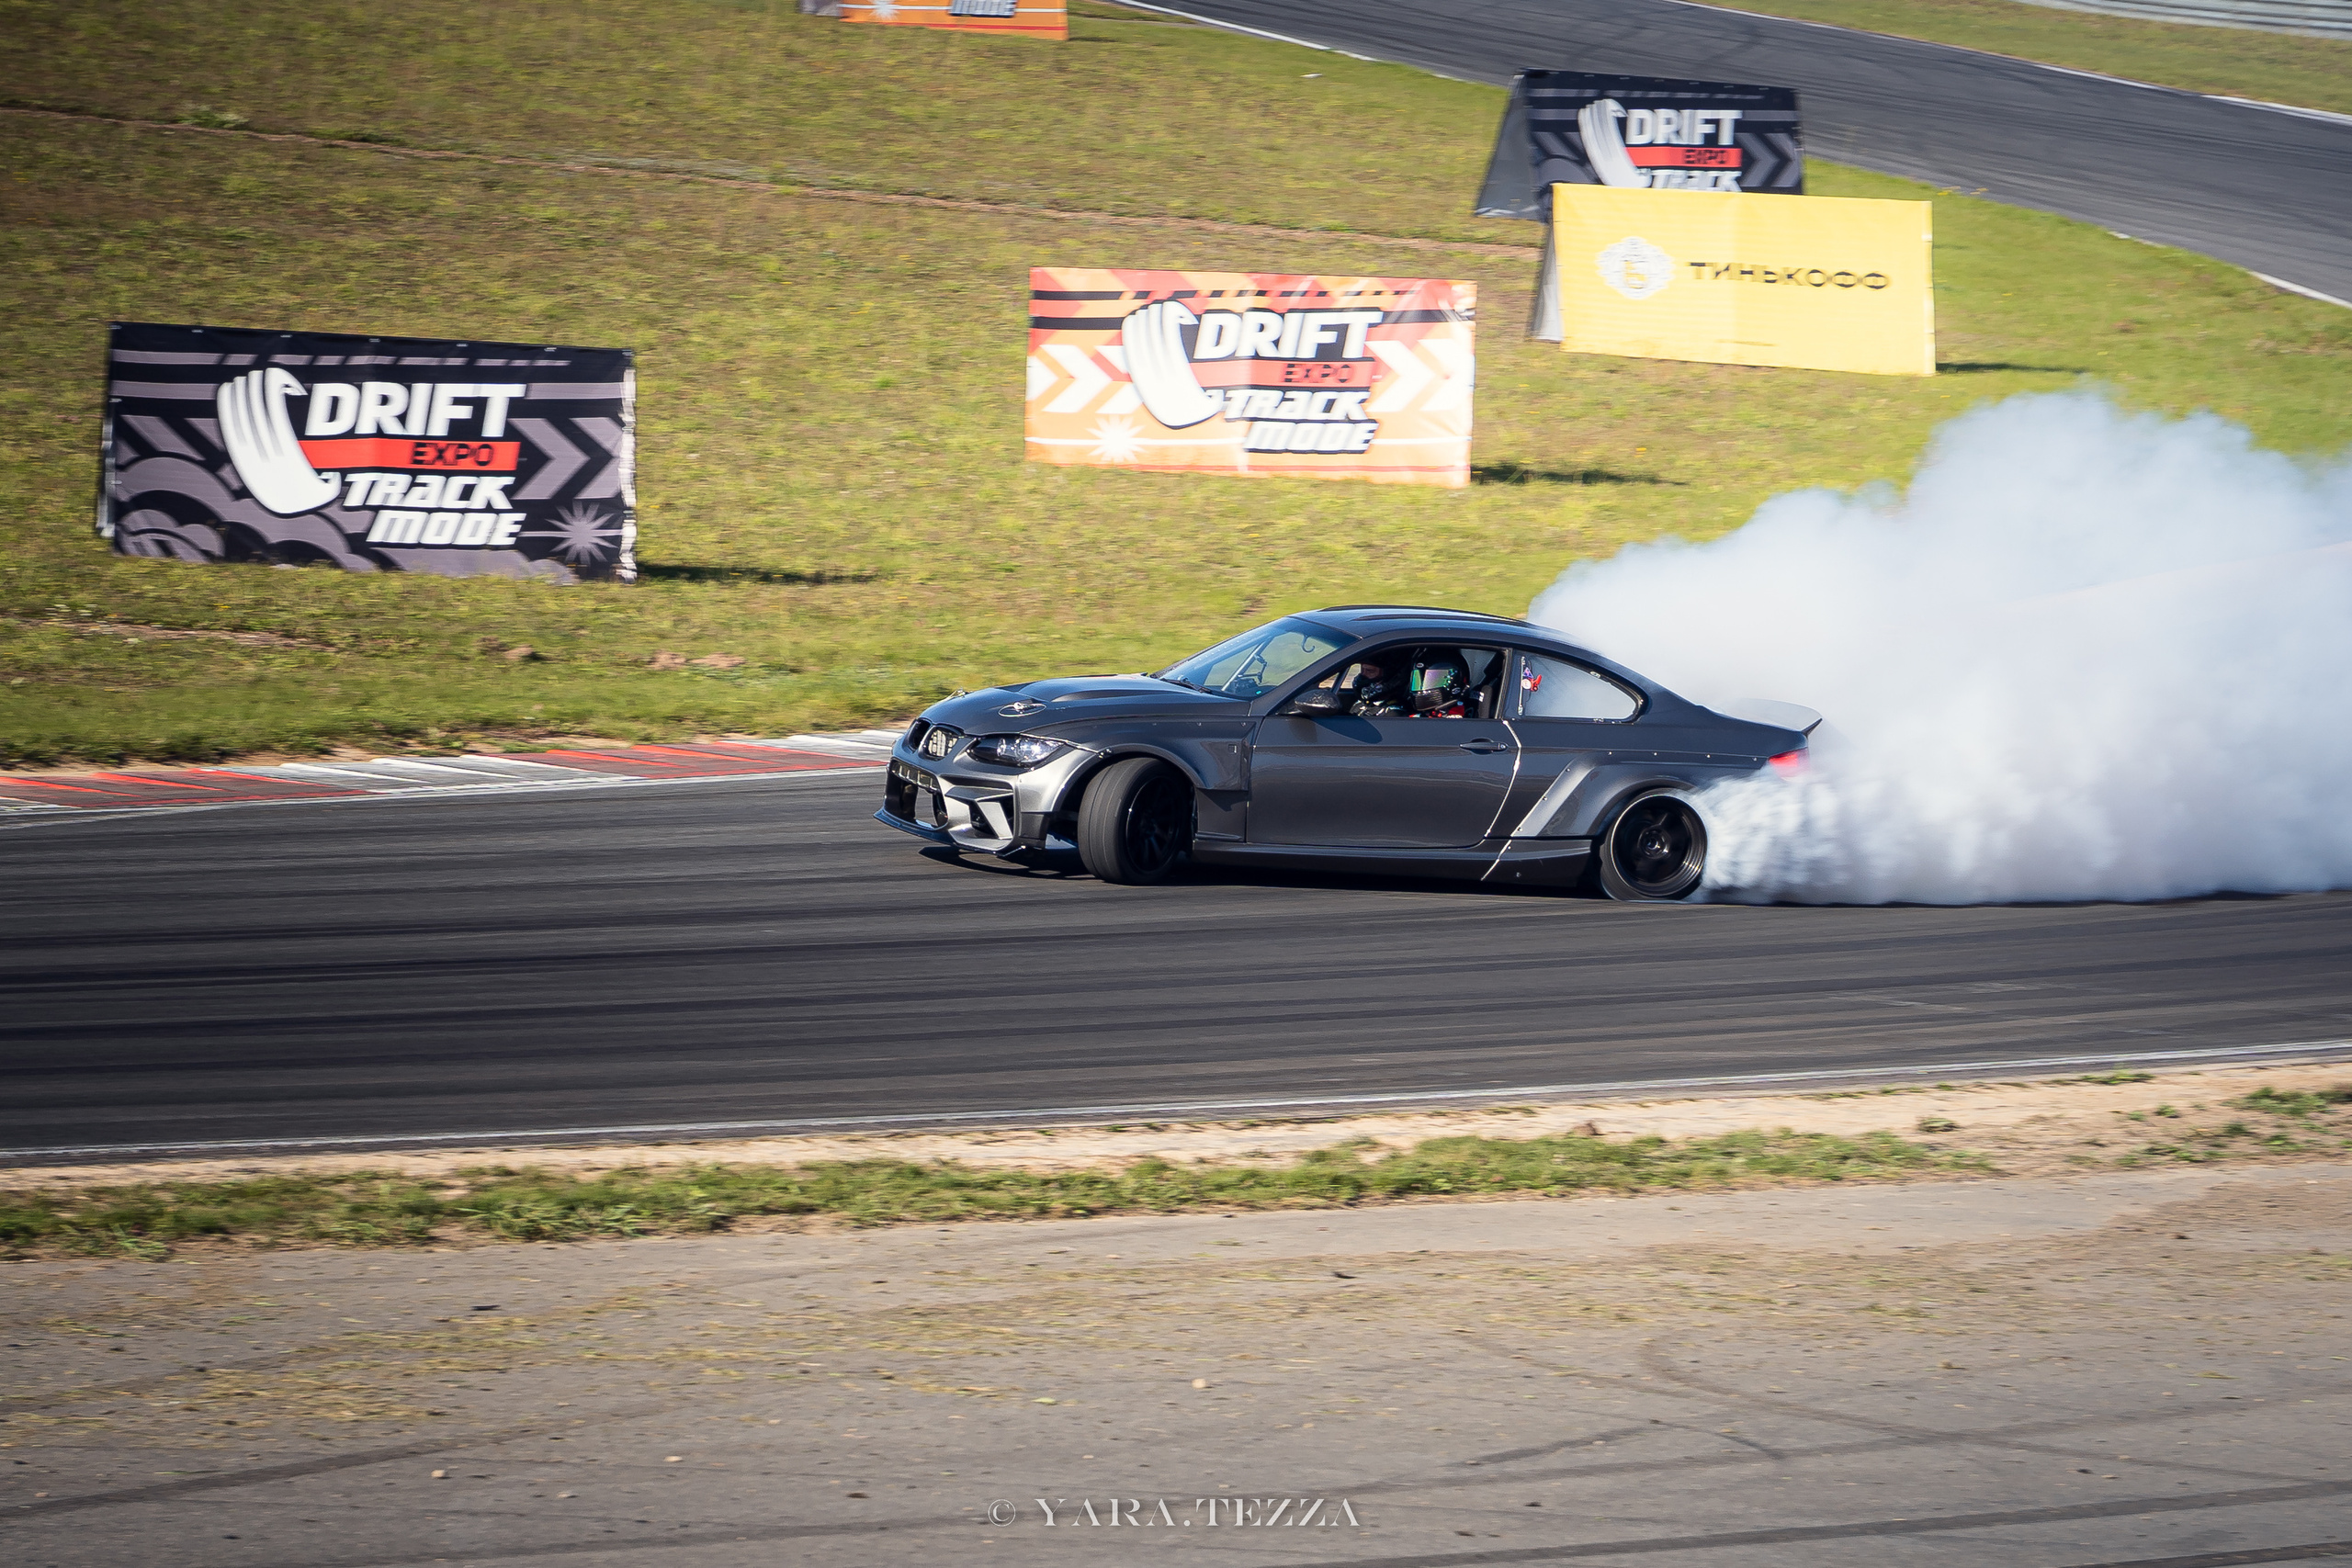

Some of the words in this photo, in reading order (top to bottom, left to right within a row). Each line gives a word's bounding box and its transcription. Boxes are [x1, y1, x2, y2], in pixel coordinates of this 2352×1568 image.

[1626, 108, 1743, 145] DRIFT
[1683, 149, 1727, 164] EXPO
[1686, 261, 1890, 288] ТИНЬКОФФ
[1193, 310, 1383, 359] DRIFT
[1283, 363, 1353, 383] EXPO
[305, 381, 526, 437] DRIFT
[1242, 421, 1379, 450] MODE
[410, 442, 494, 467] EXPO
[366, 510, 526, 545] MODE
